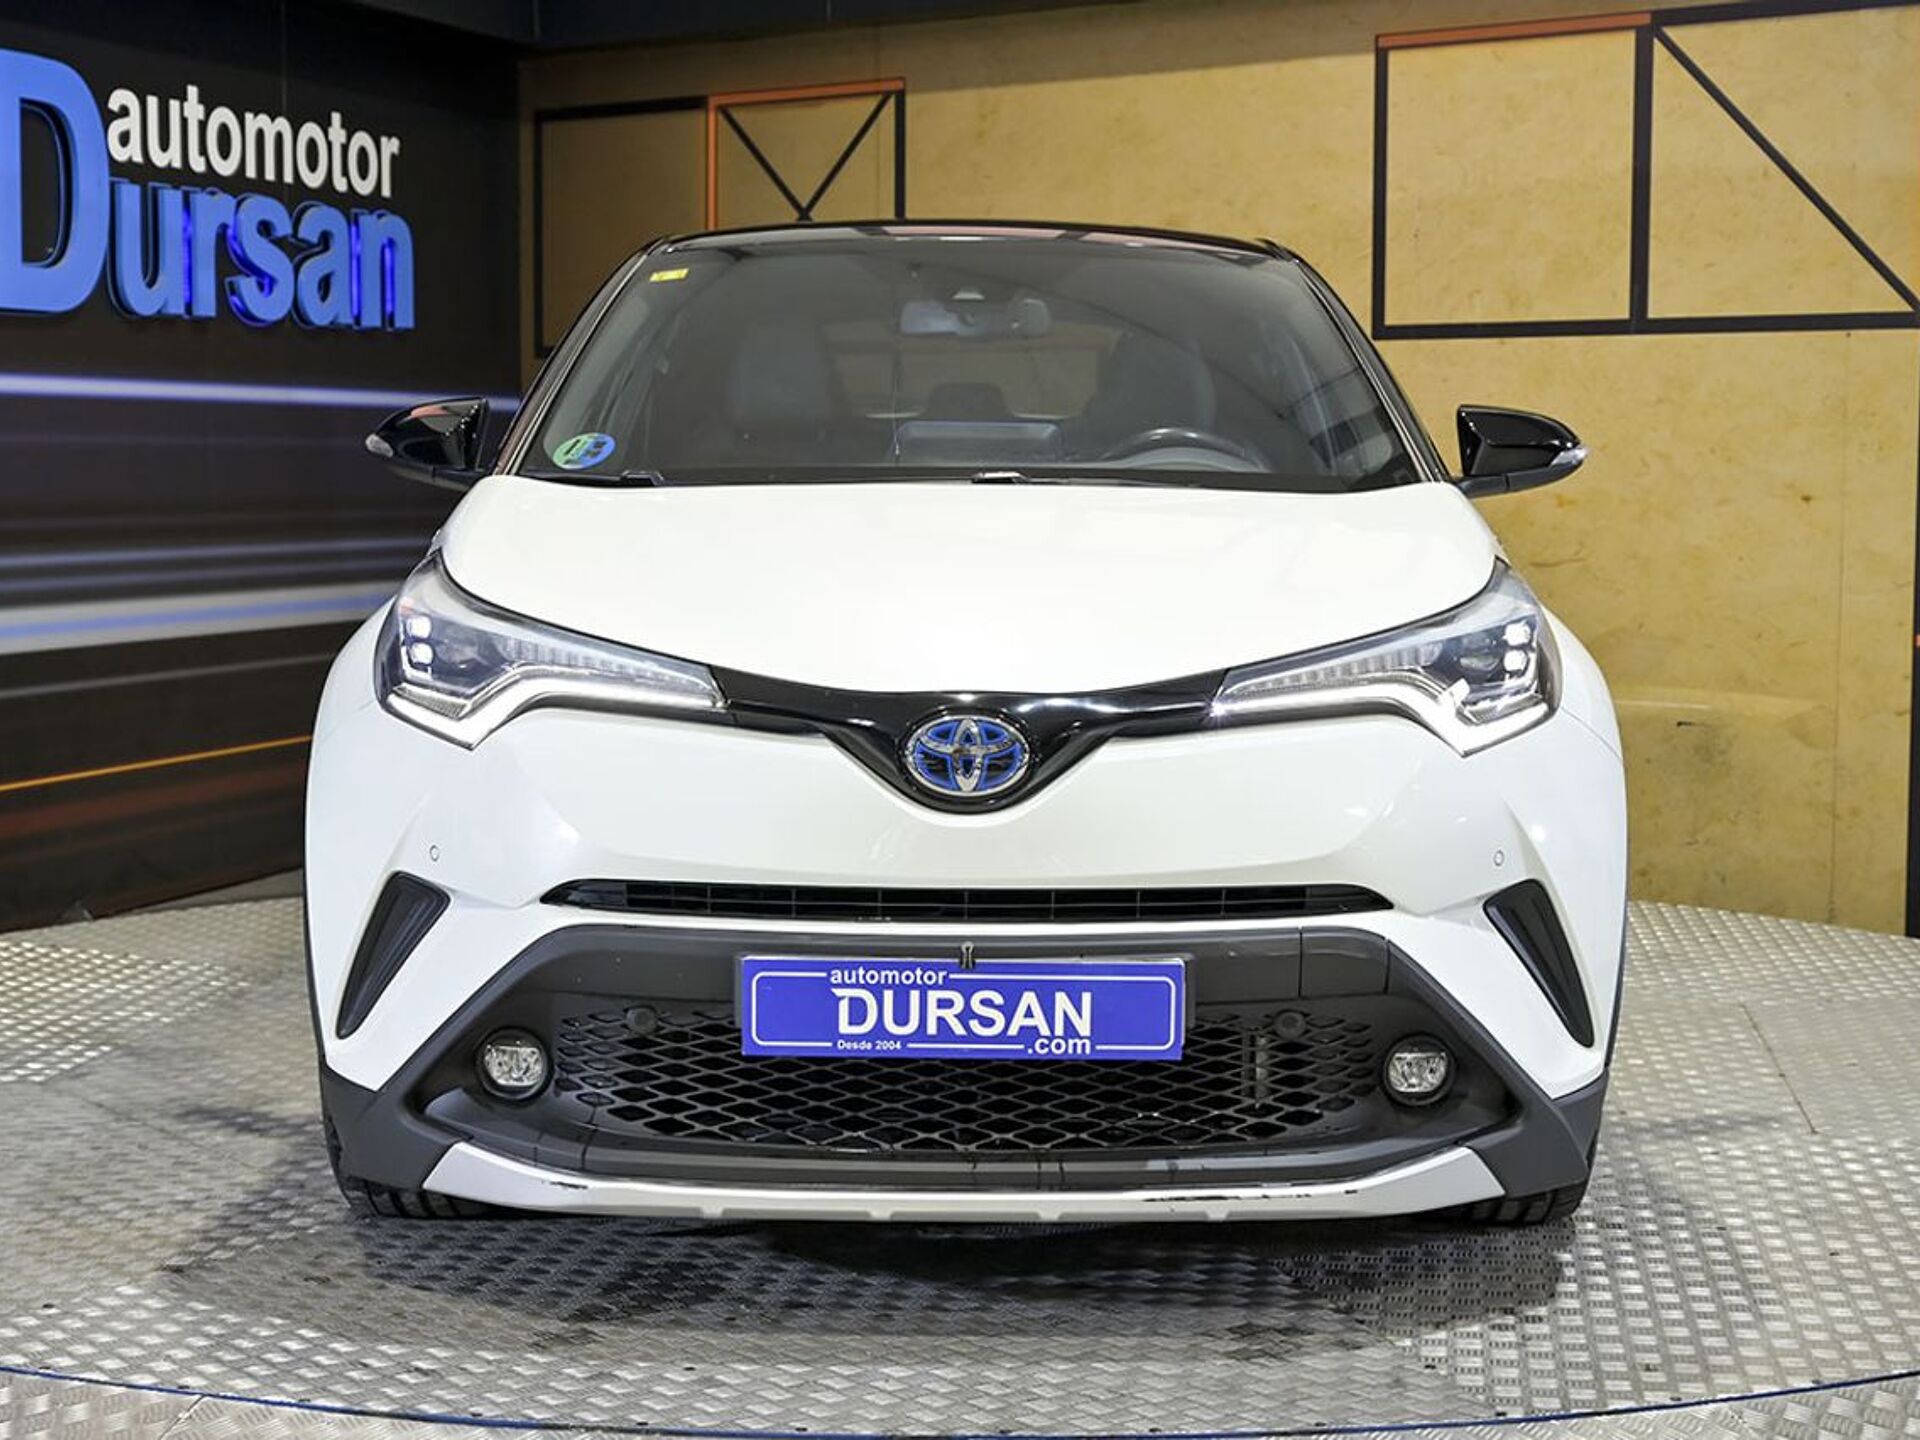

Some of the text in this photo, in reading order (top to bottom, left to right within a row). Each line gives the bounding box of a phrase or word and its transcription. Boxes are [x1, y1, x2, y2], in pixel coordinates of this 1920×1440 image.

[106, 85, 401, 198] automotor
[0, 48, 416, 331] Dursan
[830, 965, 947, 985] automotor
[831, 988, 1092, 1038] DURSAN
[836, 1039, 901, 1051] Desde 2004
[1027, 1037, 1092, 1055] .com
